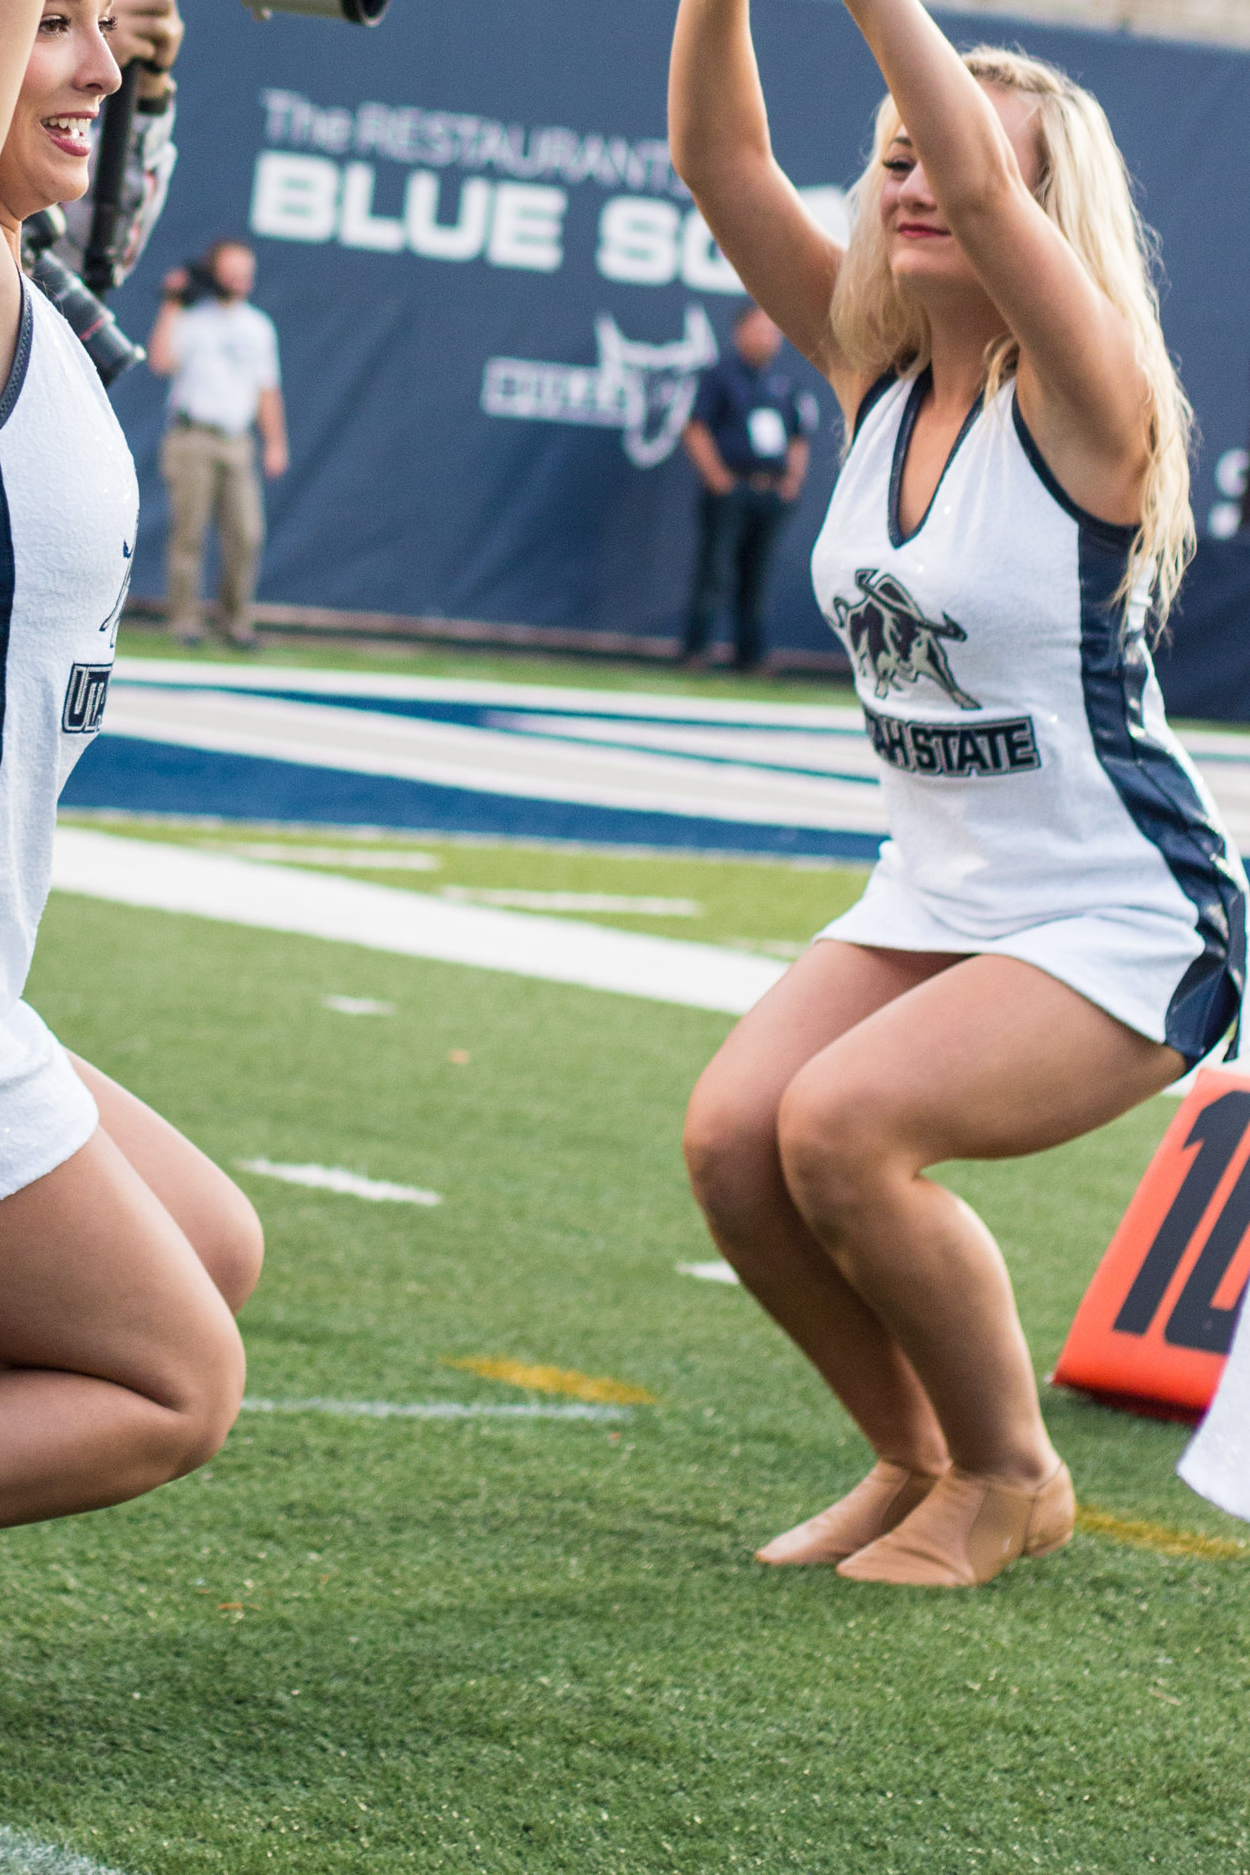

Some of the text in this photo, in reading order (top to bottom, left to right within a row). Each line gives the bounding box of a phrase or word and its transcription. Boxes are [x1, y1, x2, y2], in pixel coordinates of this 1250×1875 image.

[261, 87, 350, 155] The
[253, 150, 568, 272] BLUE
[907, 717, 1041, 777] STATE
